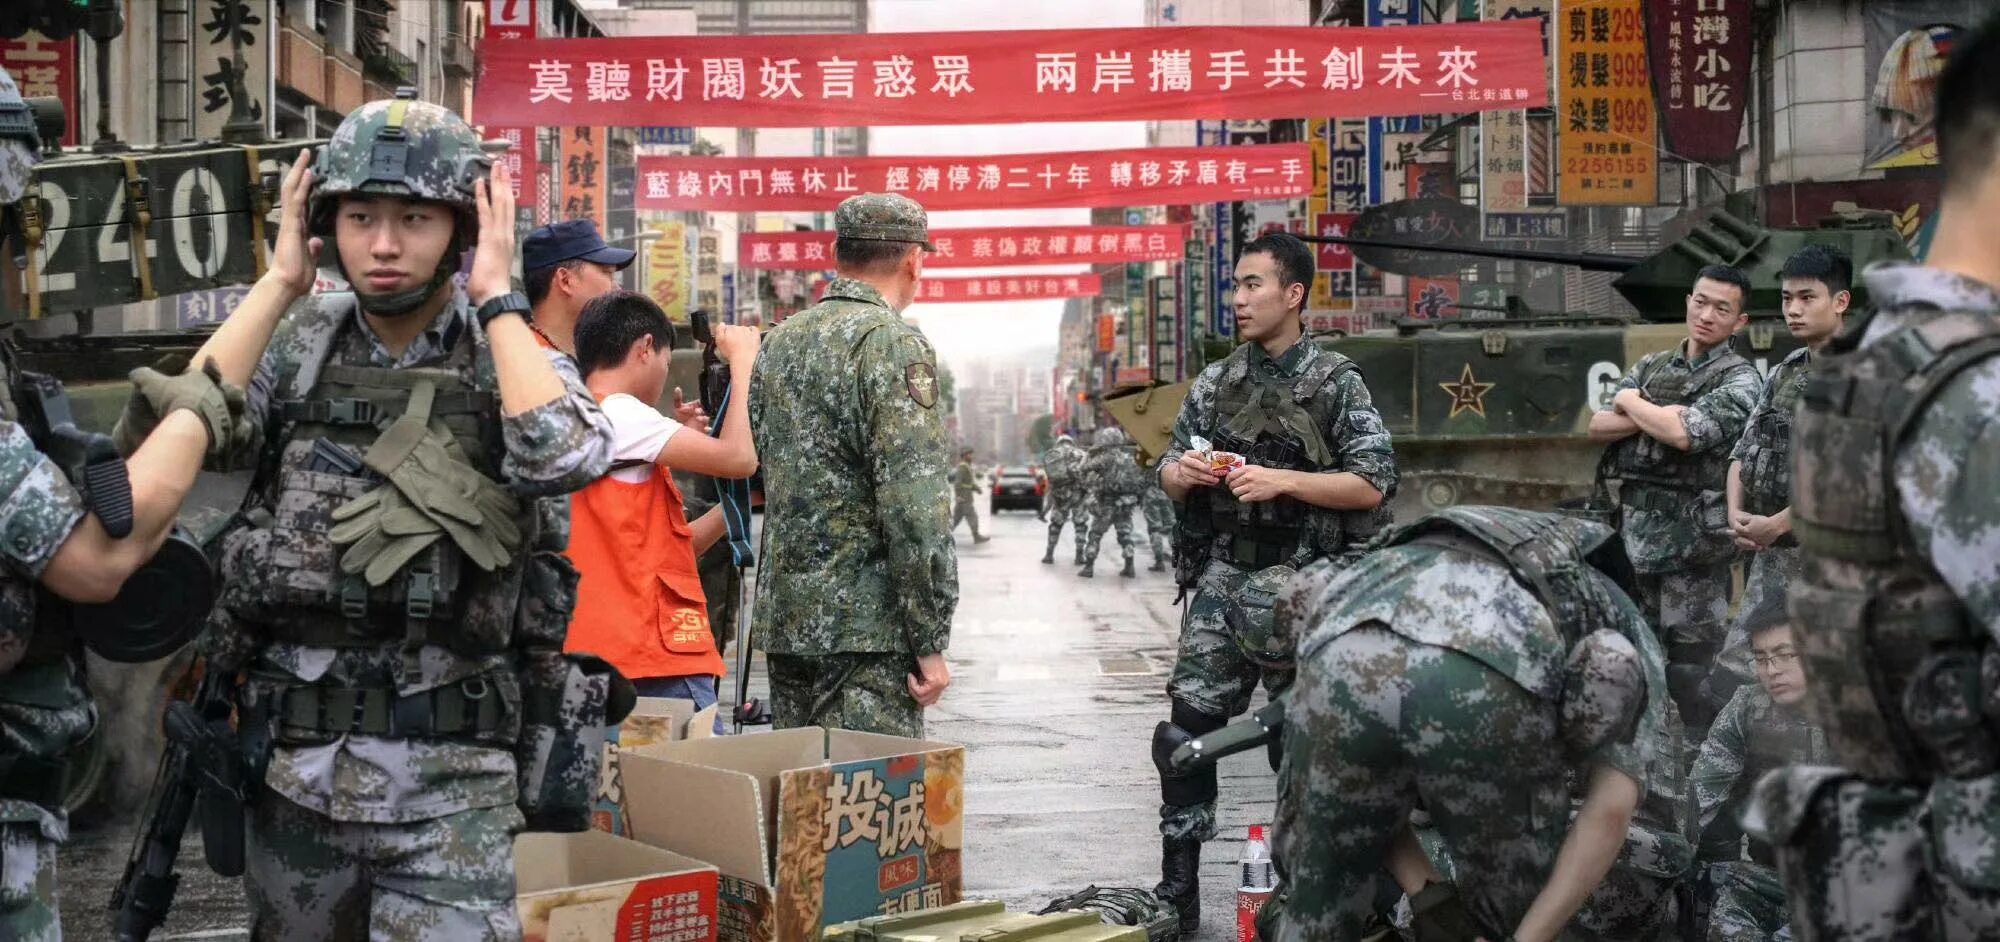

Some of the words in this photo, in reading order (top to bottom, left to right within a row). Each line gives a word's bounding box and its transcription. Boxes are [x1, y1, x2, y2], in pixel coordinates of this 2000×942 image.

[528, 55, 975, 104] 莫聽財閥妖言惑眾
[1035, 45, 1479, 94] 兩岸攜手共創未來
[1110, 159, 1304, 187] 轉移矛盾有一手
[823, 768, 926, 859] 投诚
